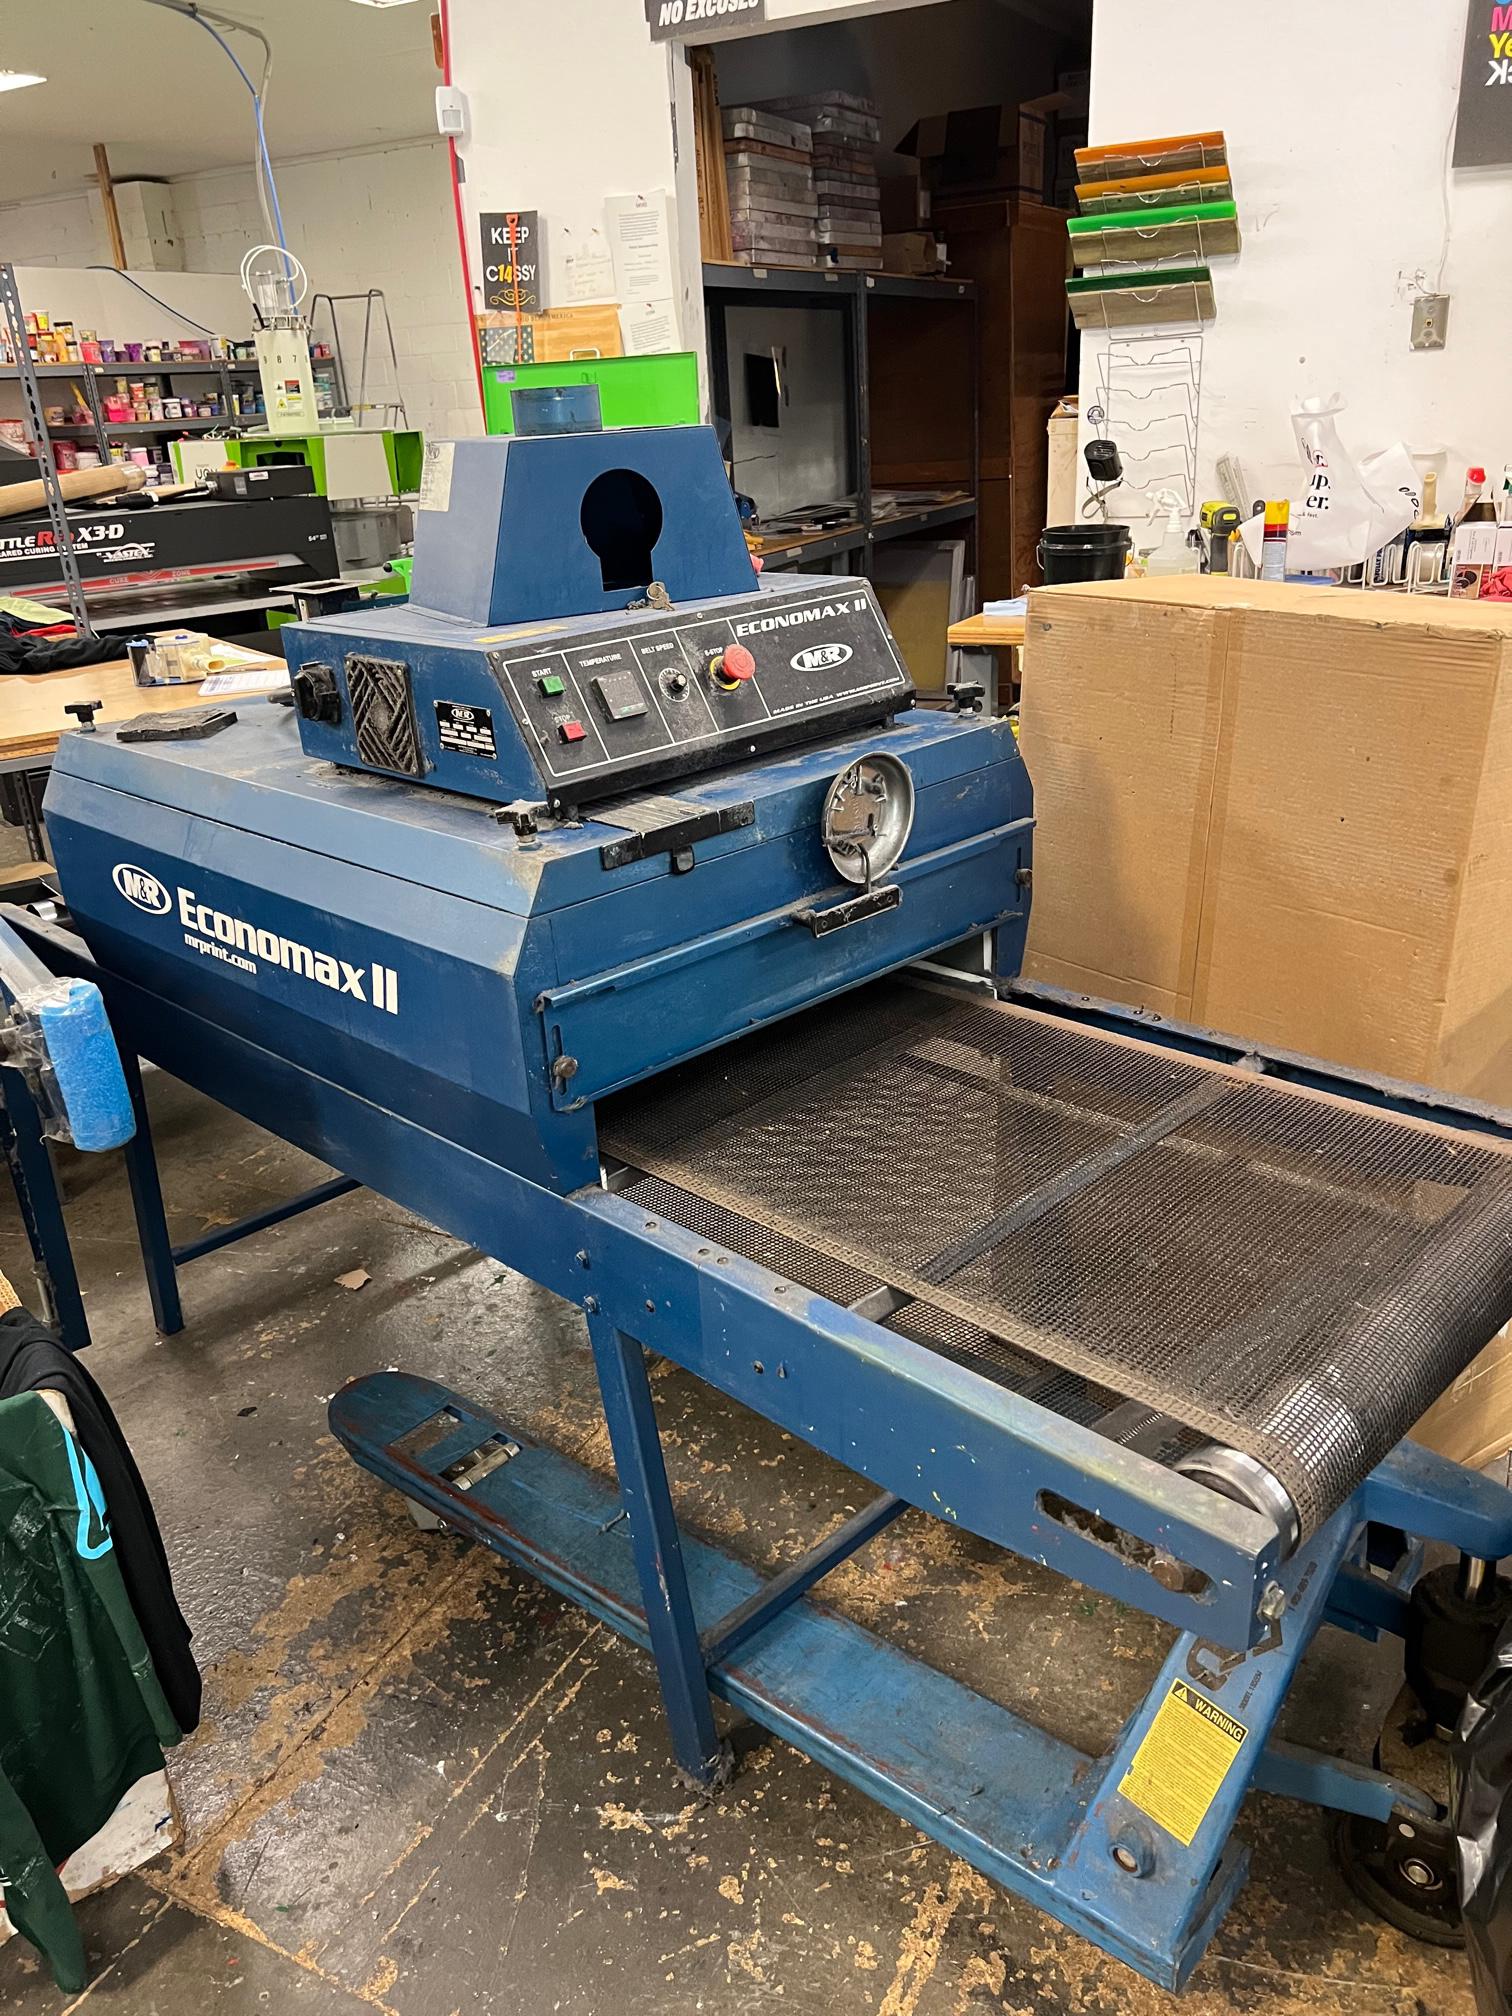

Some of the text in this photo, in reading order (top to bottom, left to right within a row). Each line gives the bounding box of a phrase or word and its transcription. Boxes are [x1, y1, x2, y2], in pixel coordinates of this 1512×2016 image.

[658, 1, 684, 27] NO
[490, 226, 530, 245] KEEP
[1305, 494, 1329, 510] er.
[0, 542, 89, 558] ARED CURING YTEM
[736, 598, 867, 637] ECONOMAX II
[640, 642, 674, 655] BELT SPEED
[802, 646, 844, 669] M&R
[578, 653, 622, 668] TEMPERATURE
[531, 667, 552, 678] START
[772, 704, 795, 715] MADE
[804, 698, 819, 706] THE
[819, 694, 834, 702] USA
[122, 868, 162, 909] M&R
[176, 886, 399, 1016] Economax II
[184, 933, 257, 975] mrprint.com
[1194, 1698, 1244, 1742] WARNING
